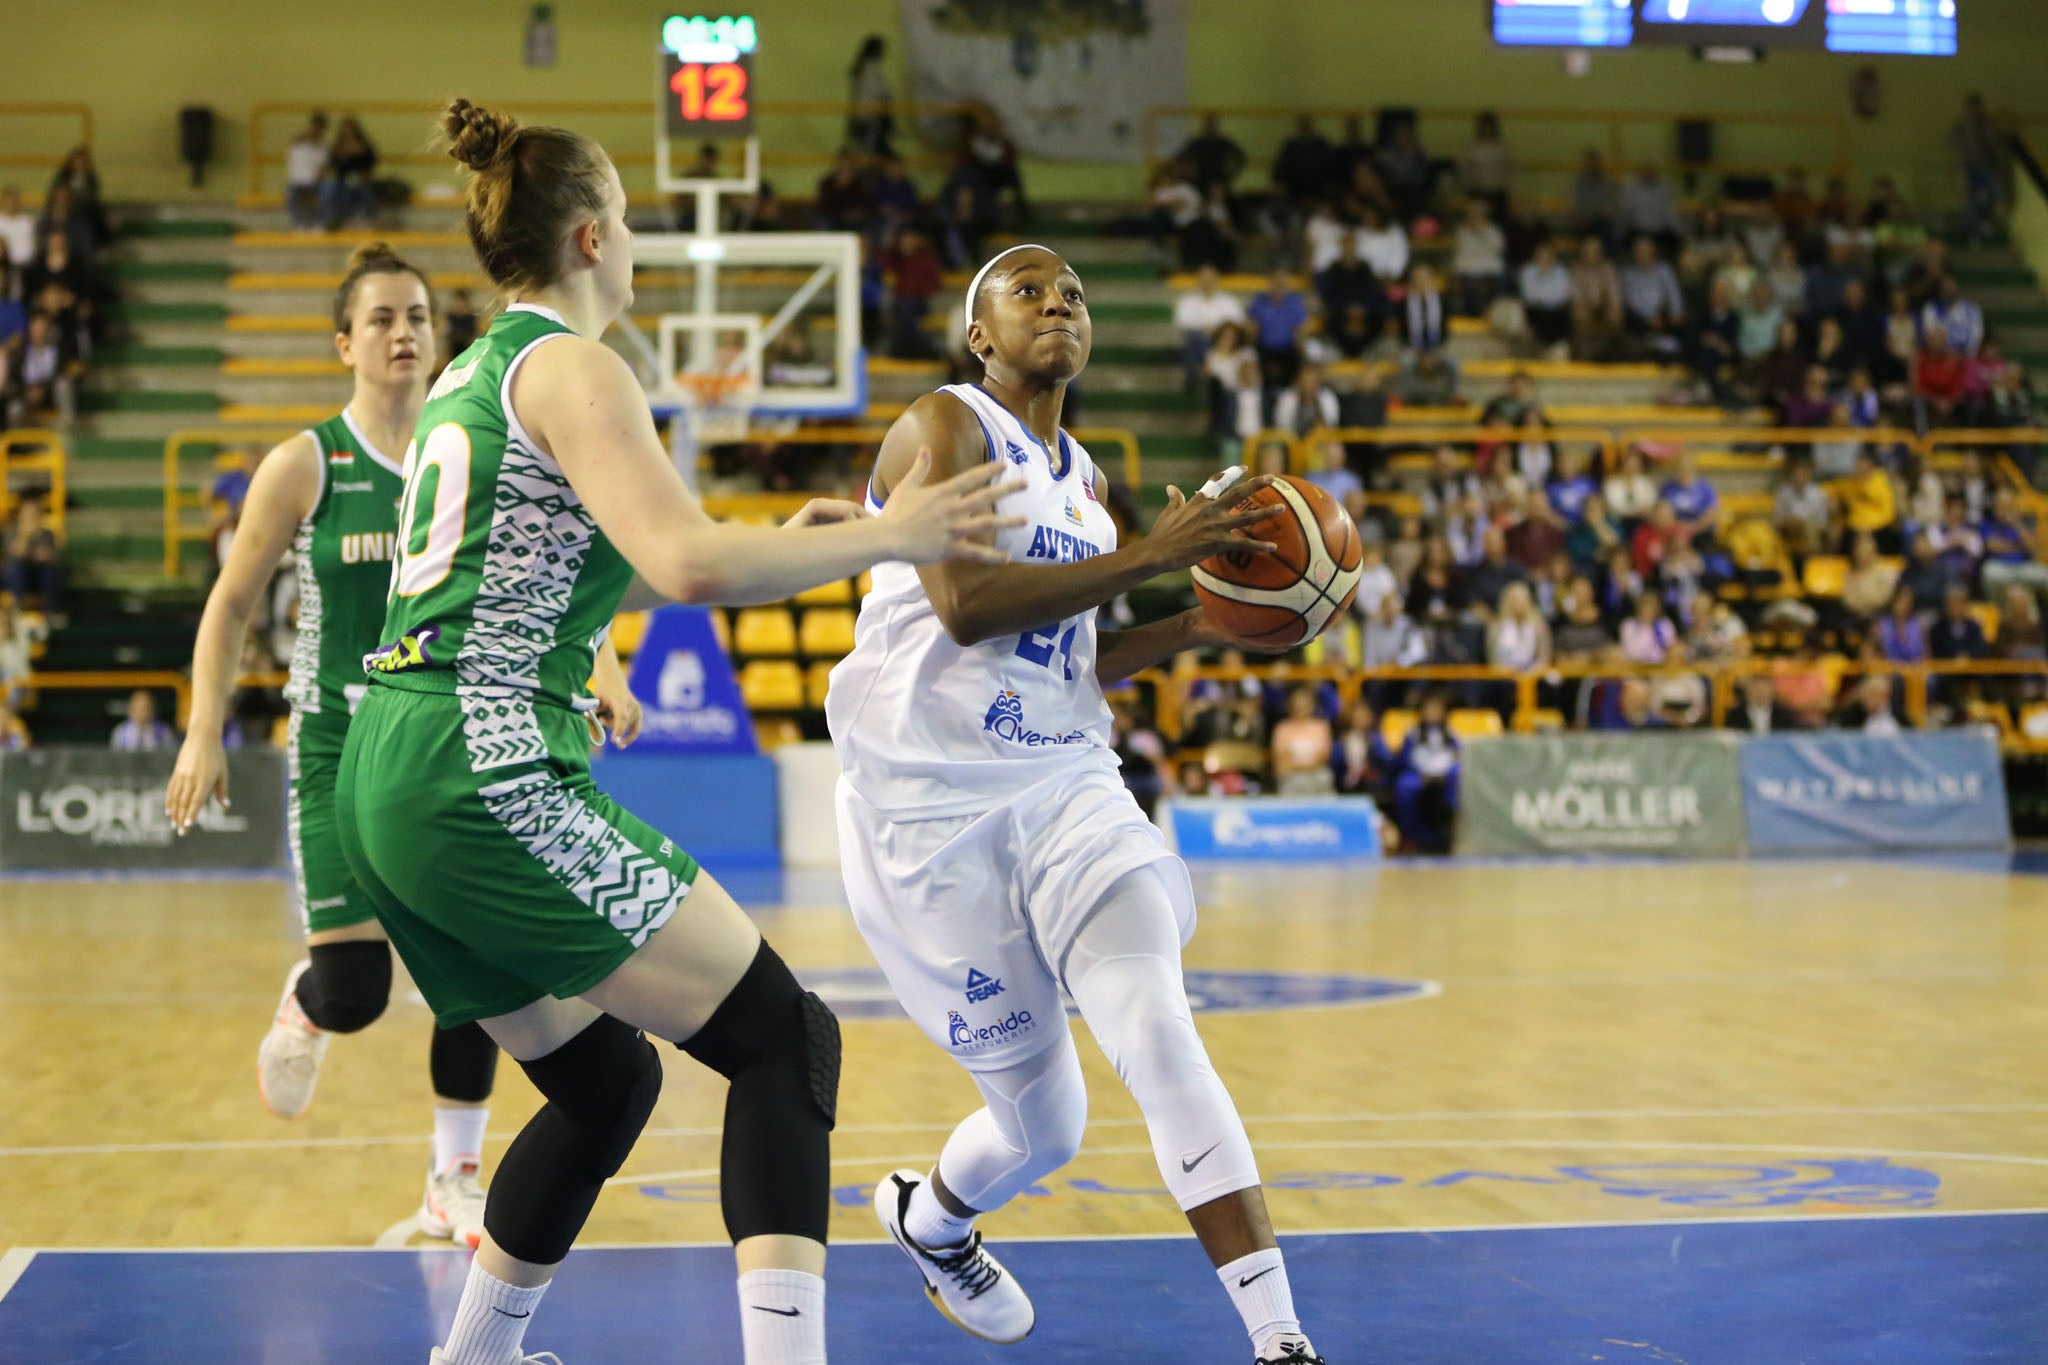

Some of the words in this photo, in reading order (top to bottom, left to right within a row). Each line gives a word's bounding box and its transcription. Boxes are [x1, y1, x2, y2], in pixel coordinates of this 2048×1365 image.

[670, 62, 748, 121] 12
[387, 421, 471, 598] 0
[965, 977, 1007, 1004] PEAK
